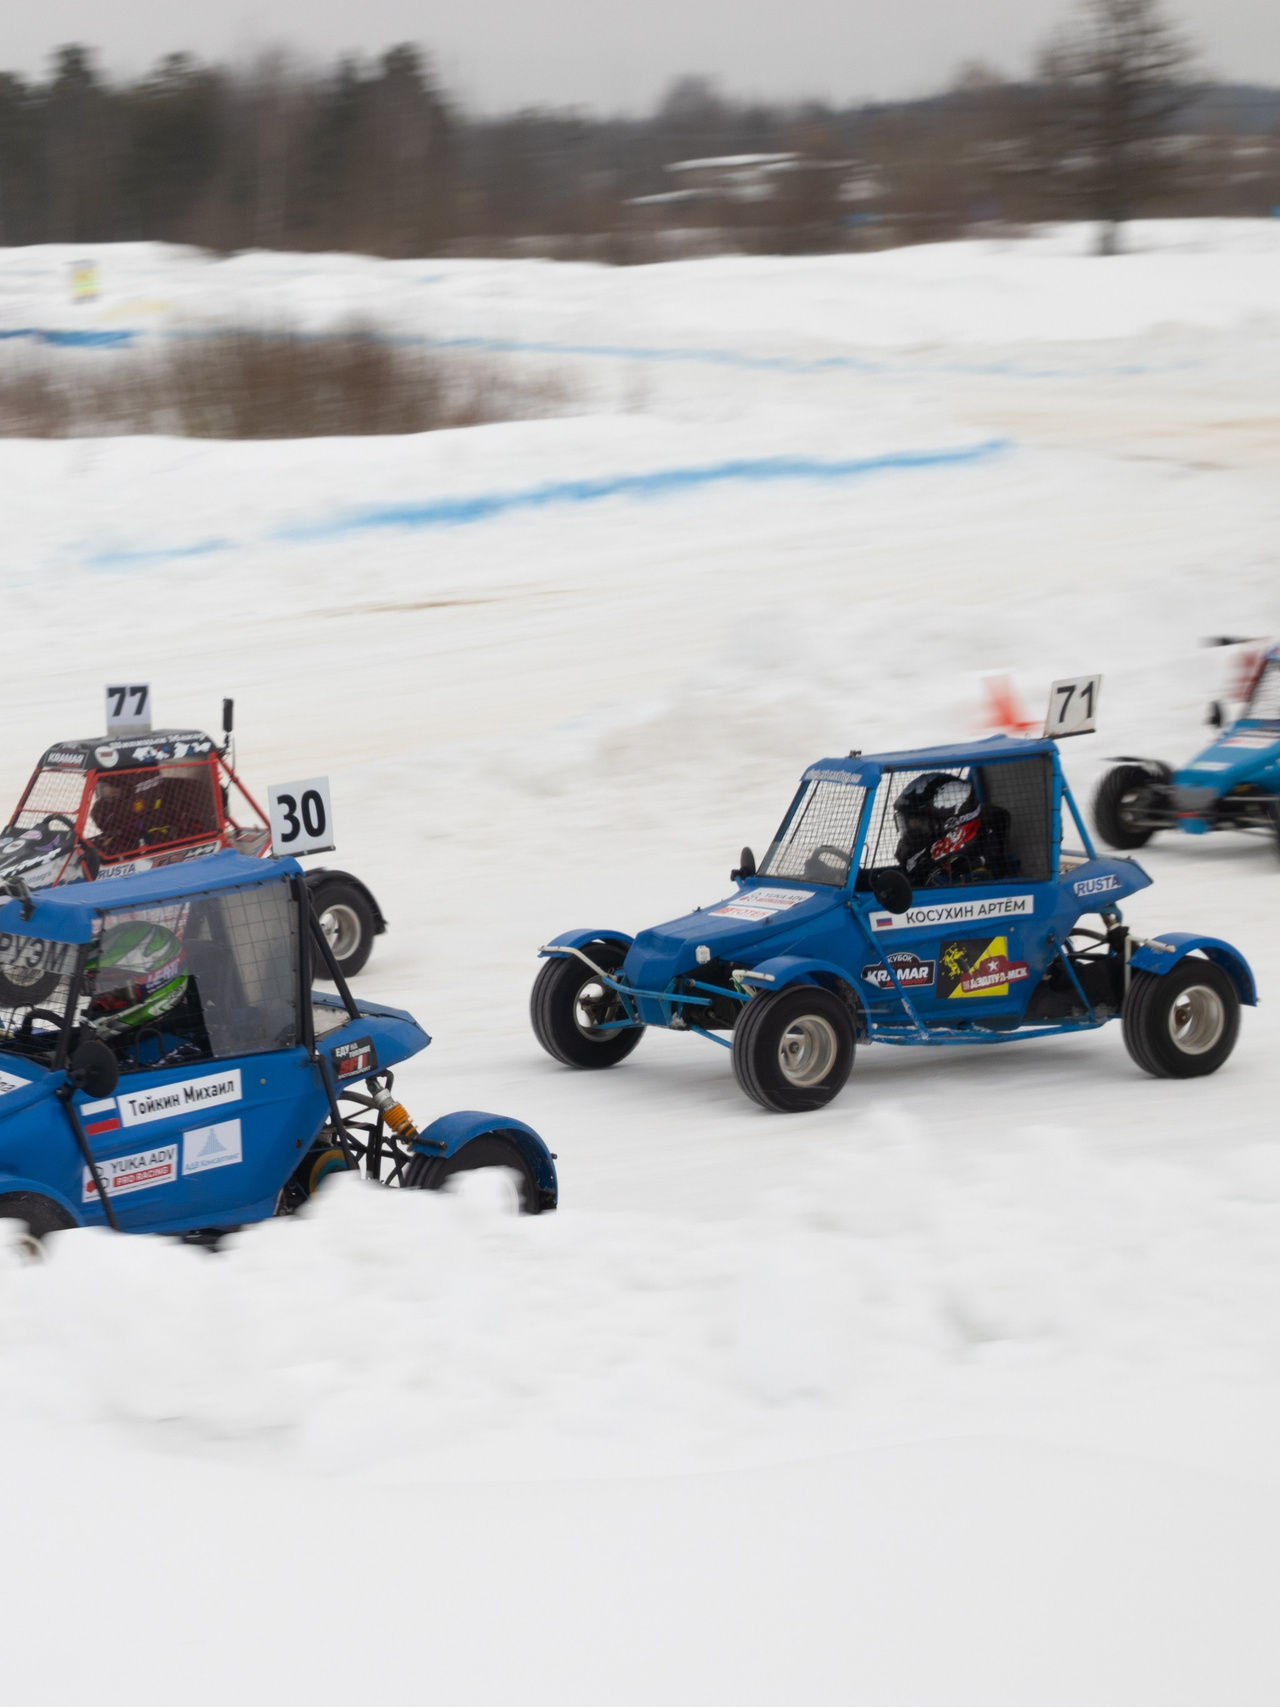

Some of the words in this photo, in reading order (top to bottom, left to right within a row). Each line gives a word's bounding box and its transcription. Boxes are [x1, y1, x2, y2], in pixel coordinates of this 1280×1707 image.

[107, 685, 148, 717] 77
[1056, 681, 1094, 724] 71
[276, 789, 326, 843] 30
[99, 863, 136, 879] RUSTA
[1076, 875, 1120, 895] RUSTA
[906, 908, 974, 925] КОСУХИН
[977, 899, 1026, 917] АРТЁМ
[866, 966, 929, 982] KRMAR
[128, 1095, 181, 1117] Тойкин
[183, 1080, 235, 1104] Михаил
[110, 1154, 148, 1174] YUKA
[148, 1147, 177, 1164] ADV
[116, 1175, 135, 1186] PRO
[136, 1166, 169, 1181] RACING
